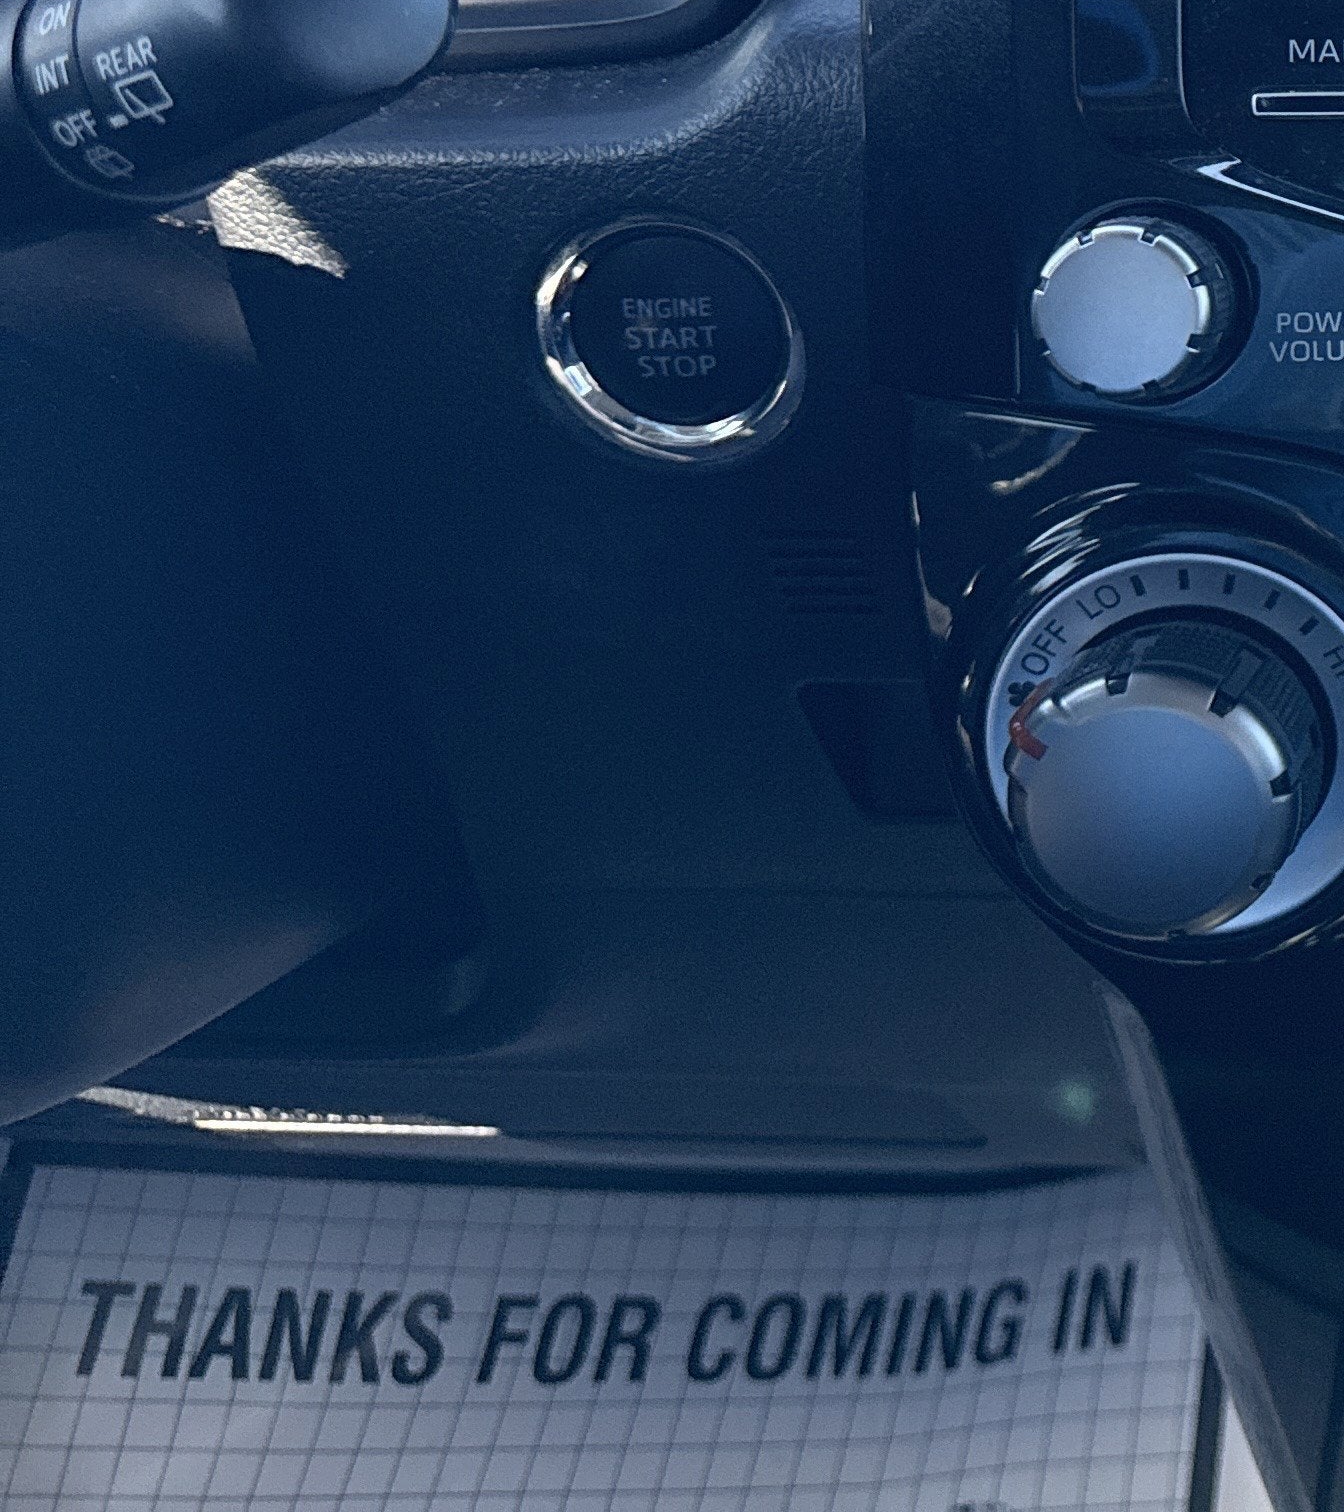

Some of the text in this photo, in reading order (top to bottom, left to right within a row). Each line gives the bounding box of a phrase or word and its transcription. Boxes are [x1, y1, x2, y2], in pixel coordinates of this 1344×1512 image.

[38, 2, 72, 37] ON
[34, 54, 71, 96] INT
[96, 35, 158, 81] REAR
[51, 108, 99, 149] OFF
[622, 297, 713, 320] ENGINE
[624, 325, 718, 351] START
[637, 355, 718, 378] STOP
[1075, 584, 1122, 620] LO
[1020, 618, 1069, 677] OFF
[75, 1259, 1139, 1386] THANKS FOR COMING IN
